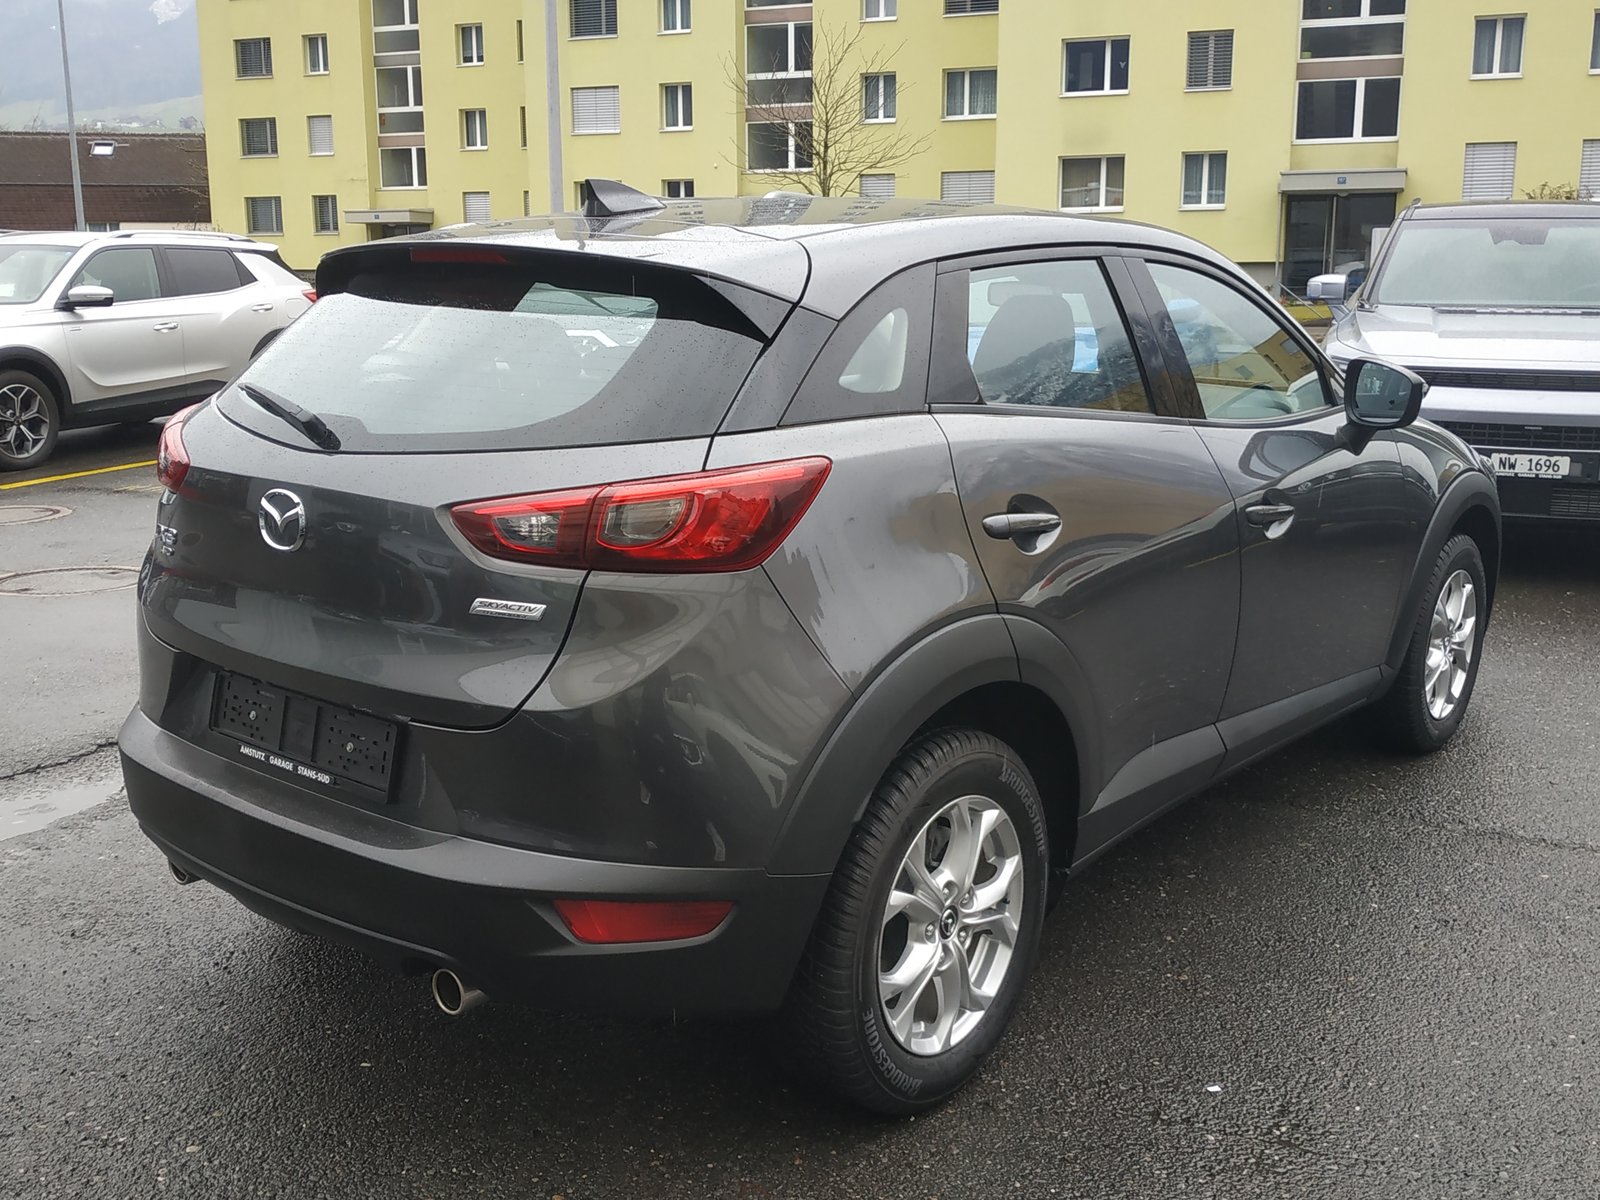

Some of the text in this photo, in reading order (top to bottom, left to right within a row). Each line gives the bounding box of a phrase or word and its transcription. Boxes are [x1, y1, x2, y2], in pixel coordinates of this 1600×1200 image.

[1498, 457, 1560, 473] NW 1696
[478, 600, 538, 613] SKYACTIV
[240, 745, 330, 784] AMSTUTZ GARAGE STANS-SÜD
[999, 766, 1046, 857] BRIDGESTONE
[862, 1007, 922, 1096] BRIDGESTONE
